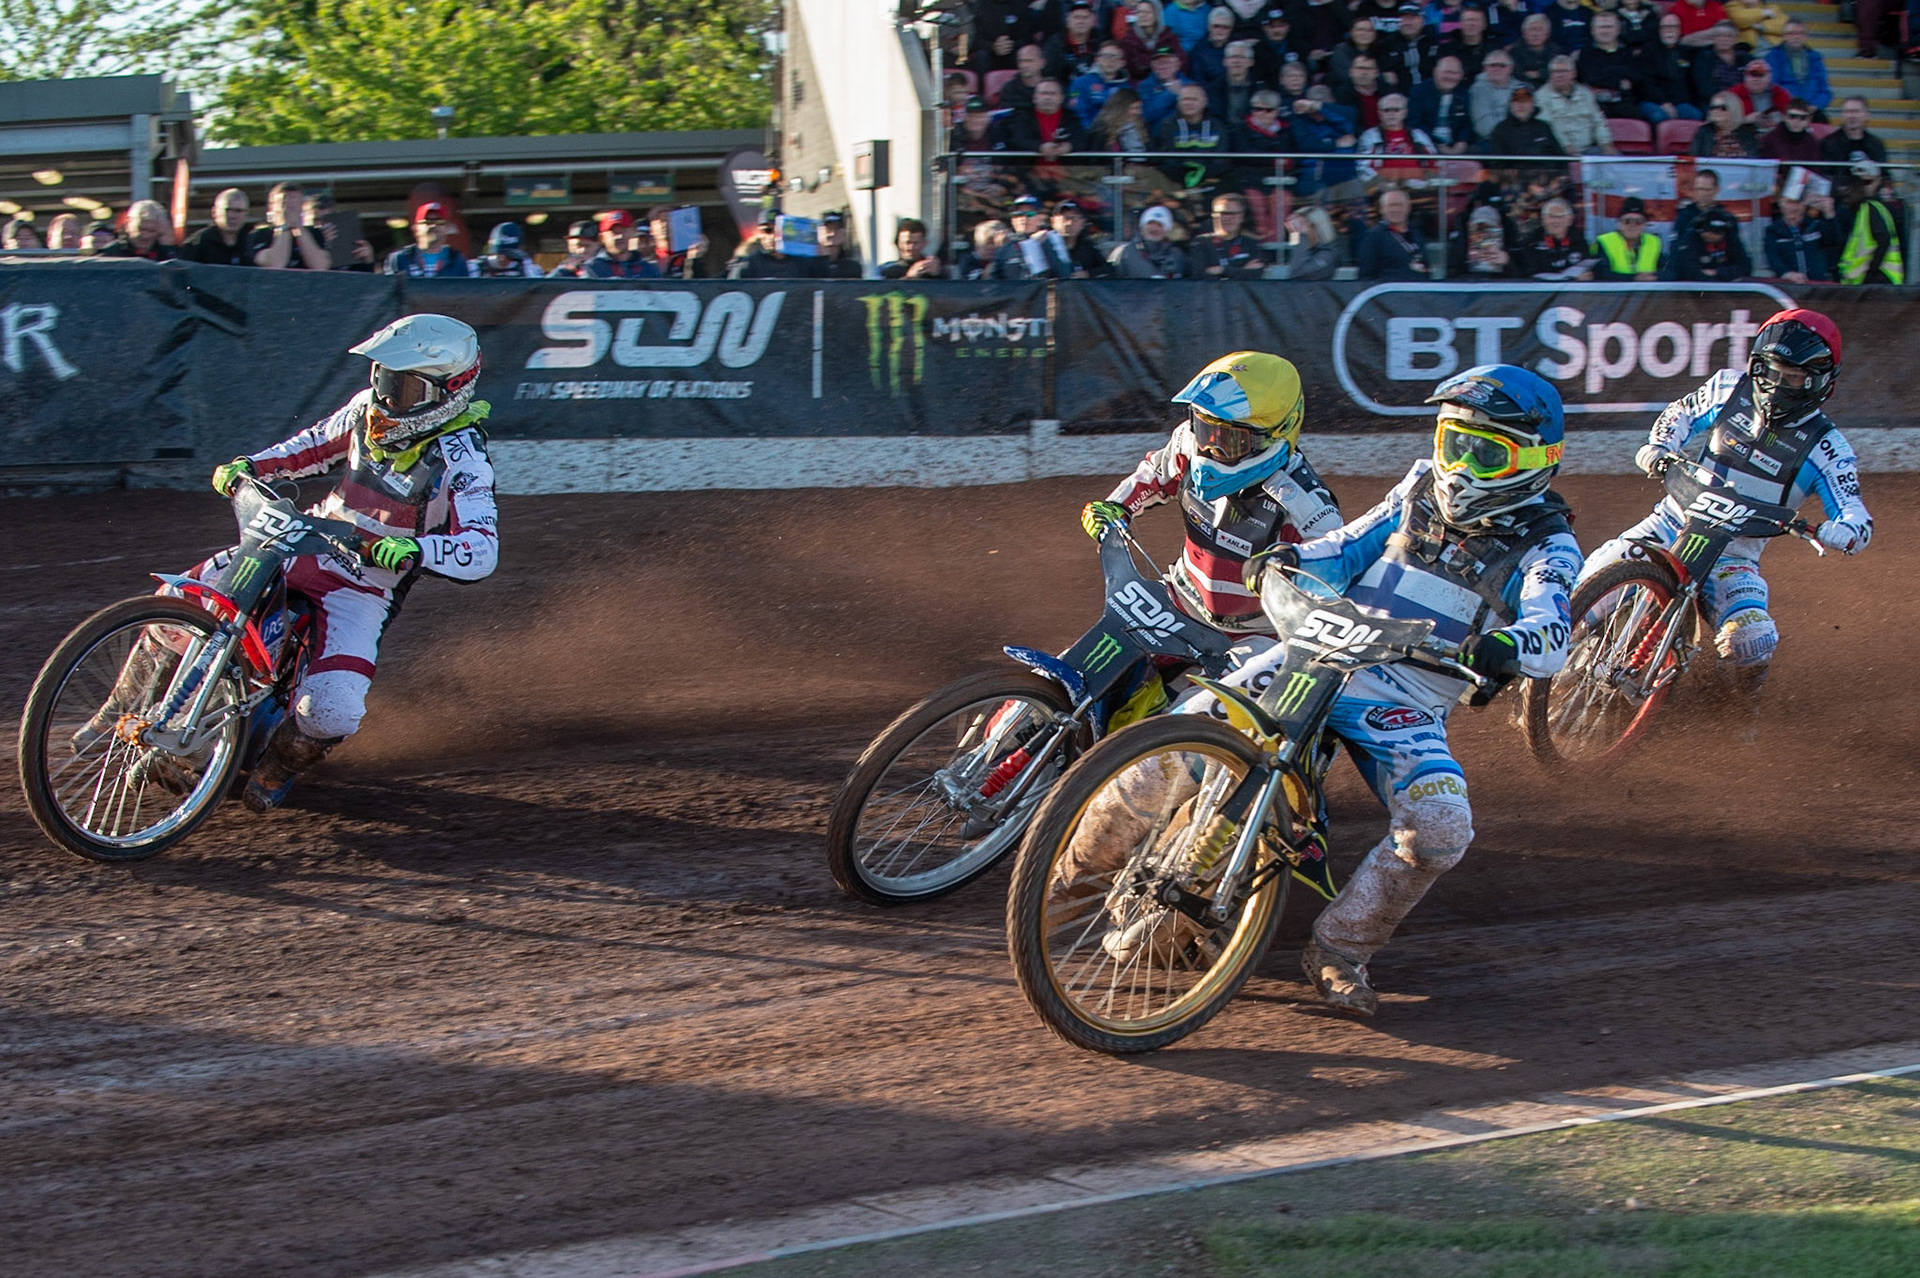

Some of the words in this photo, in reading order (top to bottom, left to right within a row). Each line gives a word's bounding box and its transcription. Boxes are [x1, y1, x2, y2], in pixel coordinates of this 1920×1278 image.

[1386, 316, 1525, 381] BT
[1535, 306, 1759, 395] Sport
[1262, 499, 1278, 513] LVA
[433, 539, 473, 567] LPG
[1226, 538, 1250, 551] ANLAS
